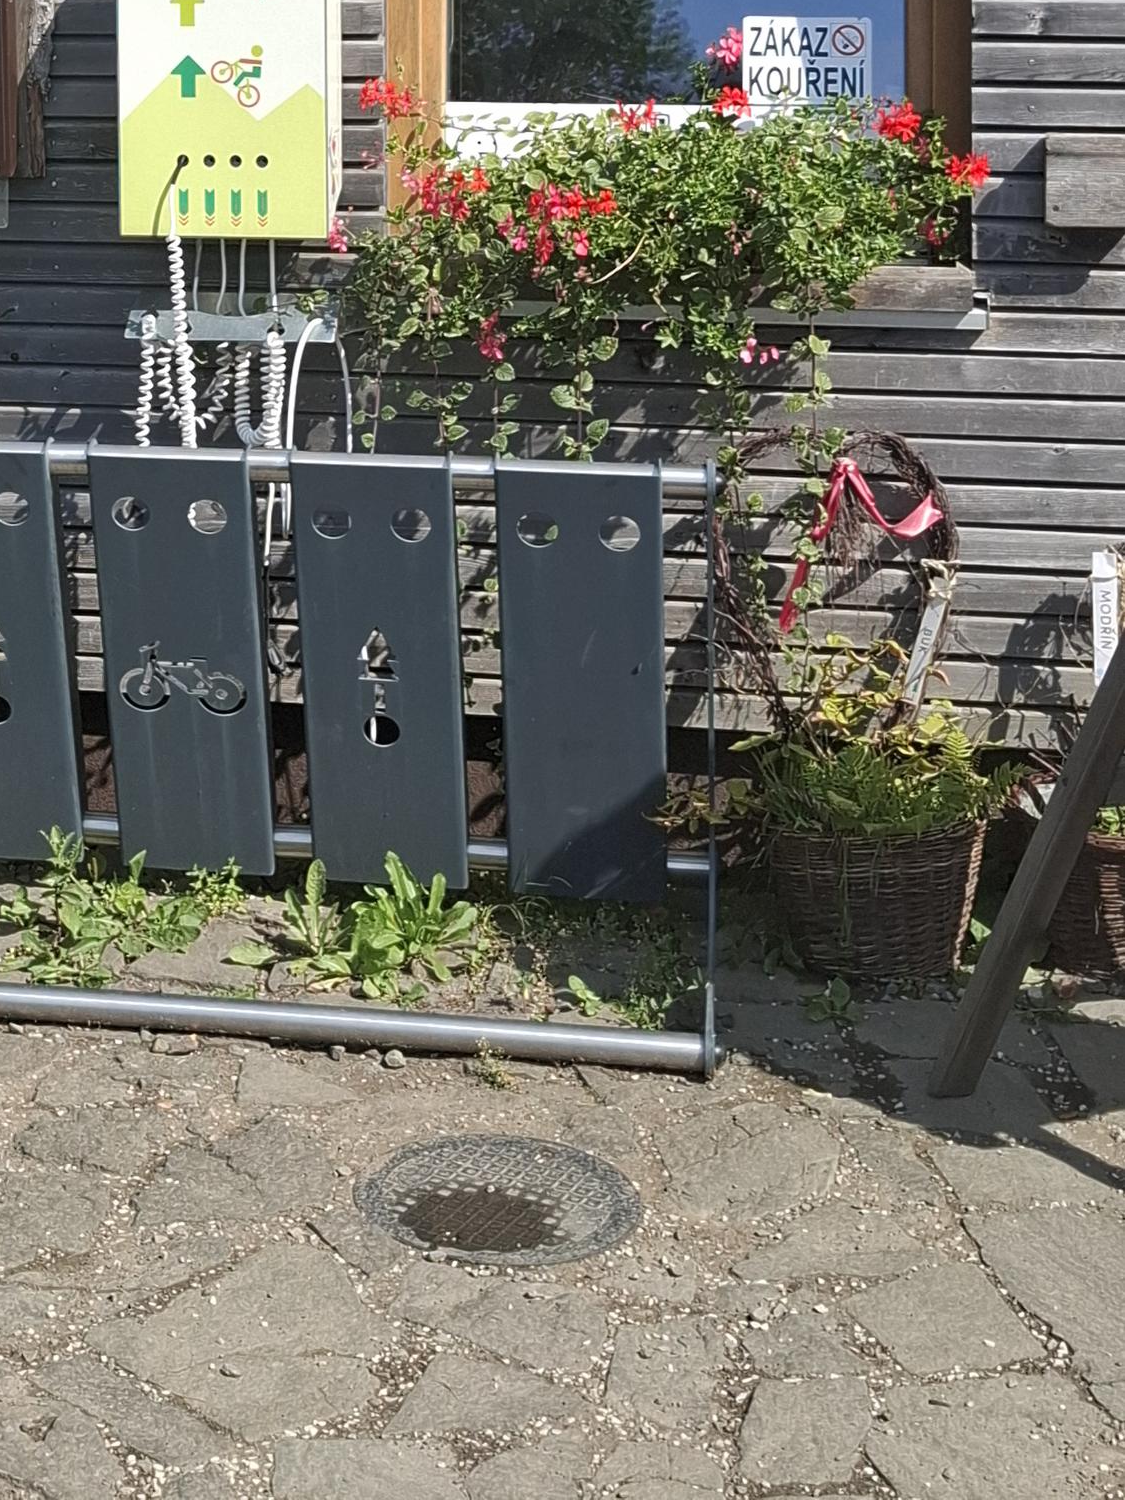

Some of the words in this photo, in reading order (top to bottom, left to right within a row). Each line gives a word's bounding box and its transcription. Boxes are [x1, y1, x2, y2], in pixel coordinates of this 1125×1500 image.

[749, 19, 829, 58] ZÁKAZ
[748, 59, 865, 98] KOUŘENÍ
[1099, 589, 1116, 650] MODŘÍN
[918, 627, 932, 652] BUK
